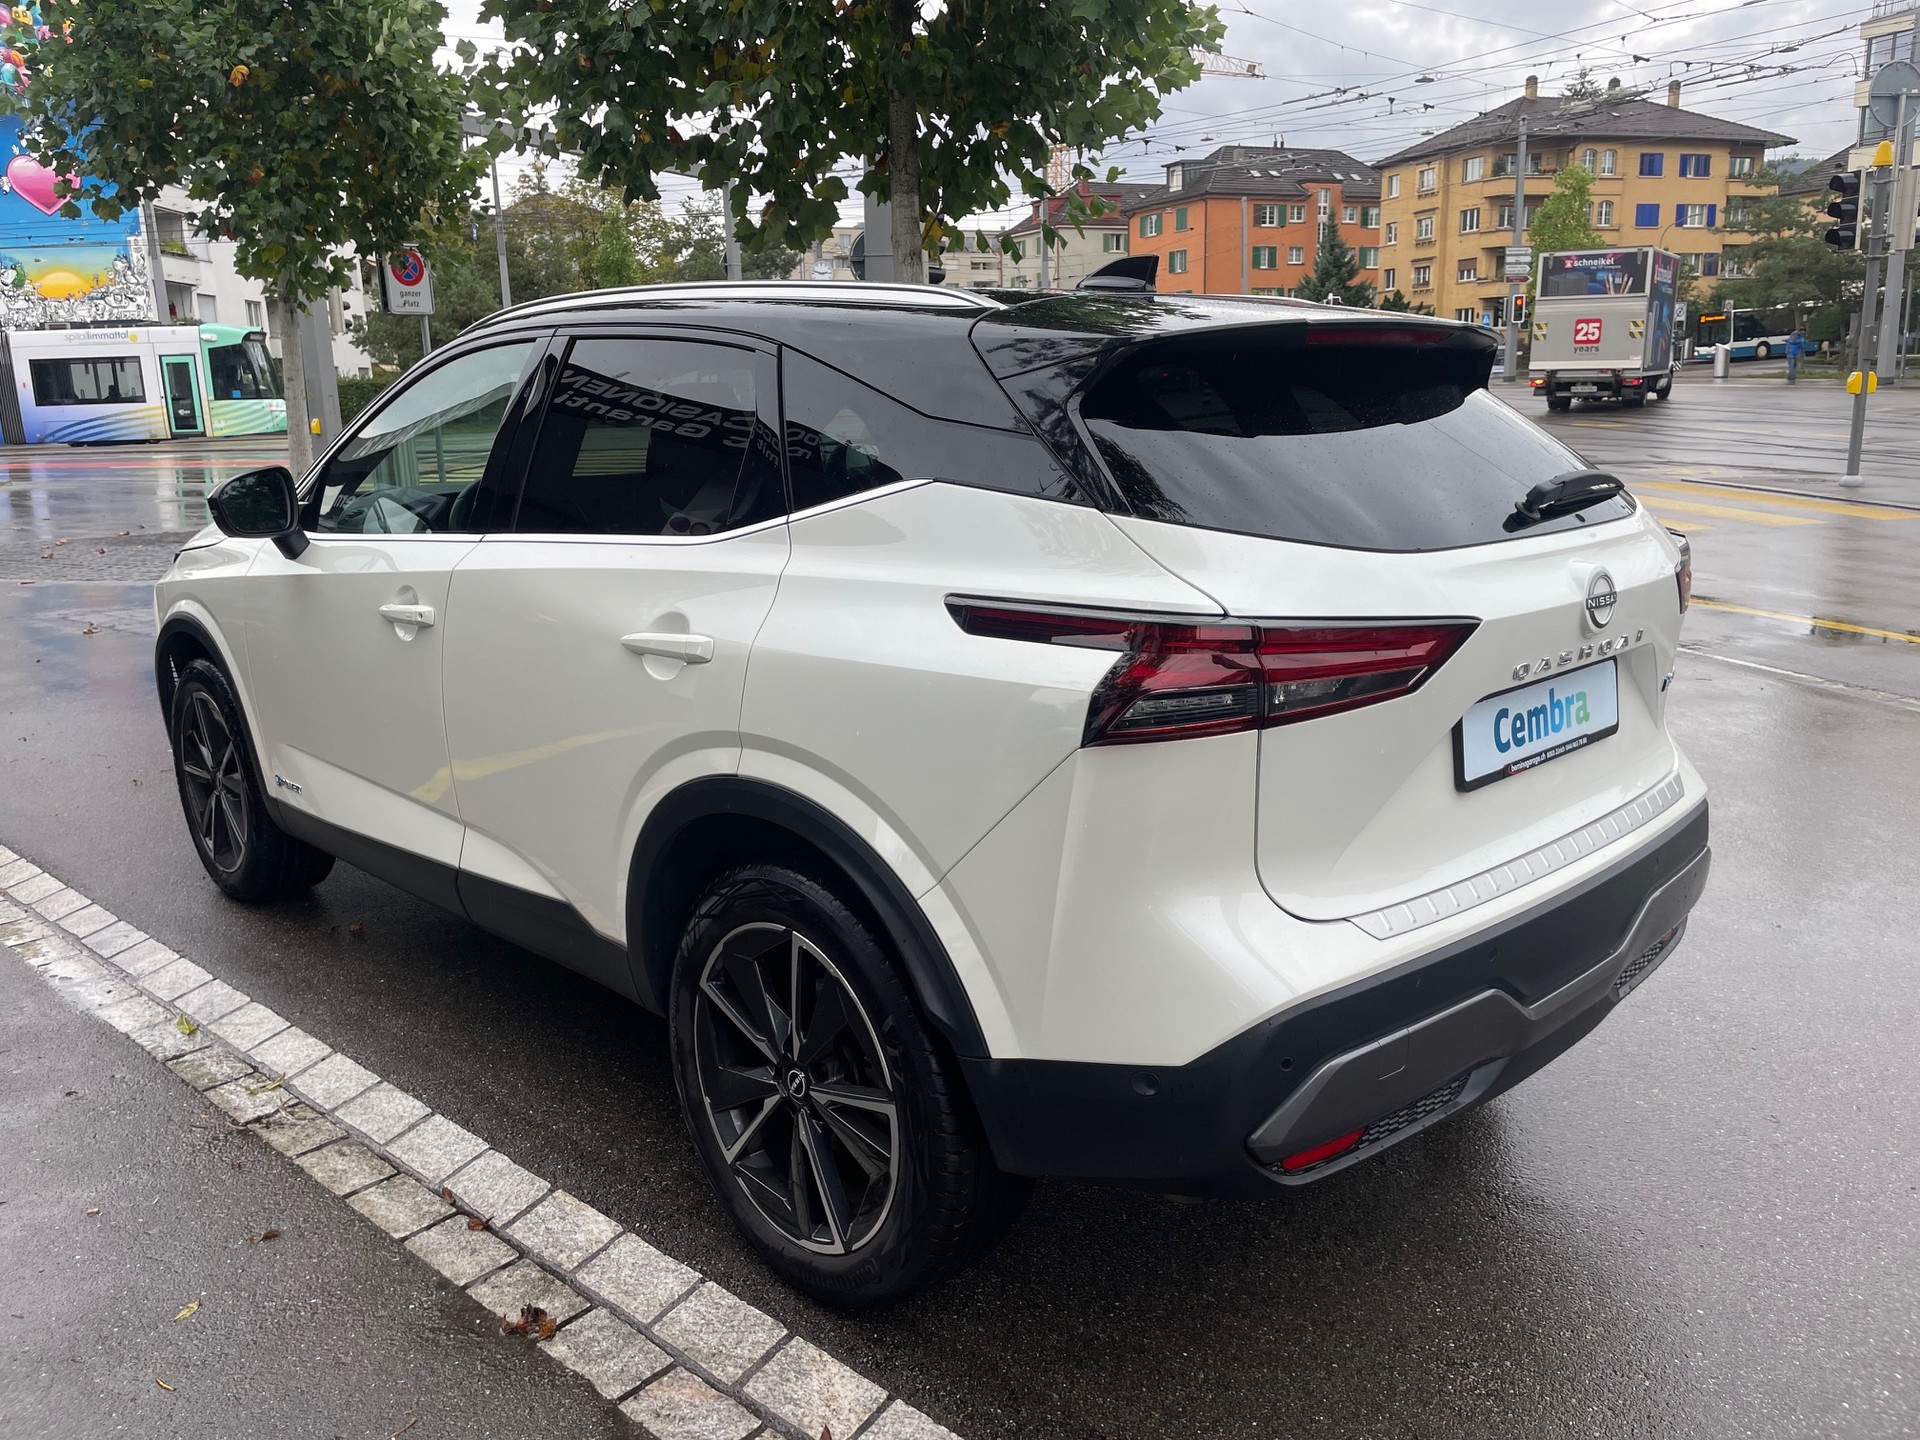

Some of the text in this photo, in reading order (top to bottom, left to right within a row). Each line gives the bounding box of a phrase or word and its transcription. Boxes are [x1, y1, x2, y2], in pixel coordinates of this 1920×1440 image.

[1573, 257, 1615, 268] schneikel
[400, 290, 421, 299] ganzer
[403, 299, 420, 308] Platz
[1575, 322, 1600, 341] 25
[1573, 344, 1600, 354] years
[1587, 593, 1616, 608] NISSA
[1512, 628, 1644, 681] QASHQAI
[1494, 687, 1590, 753] Cembra
